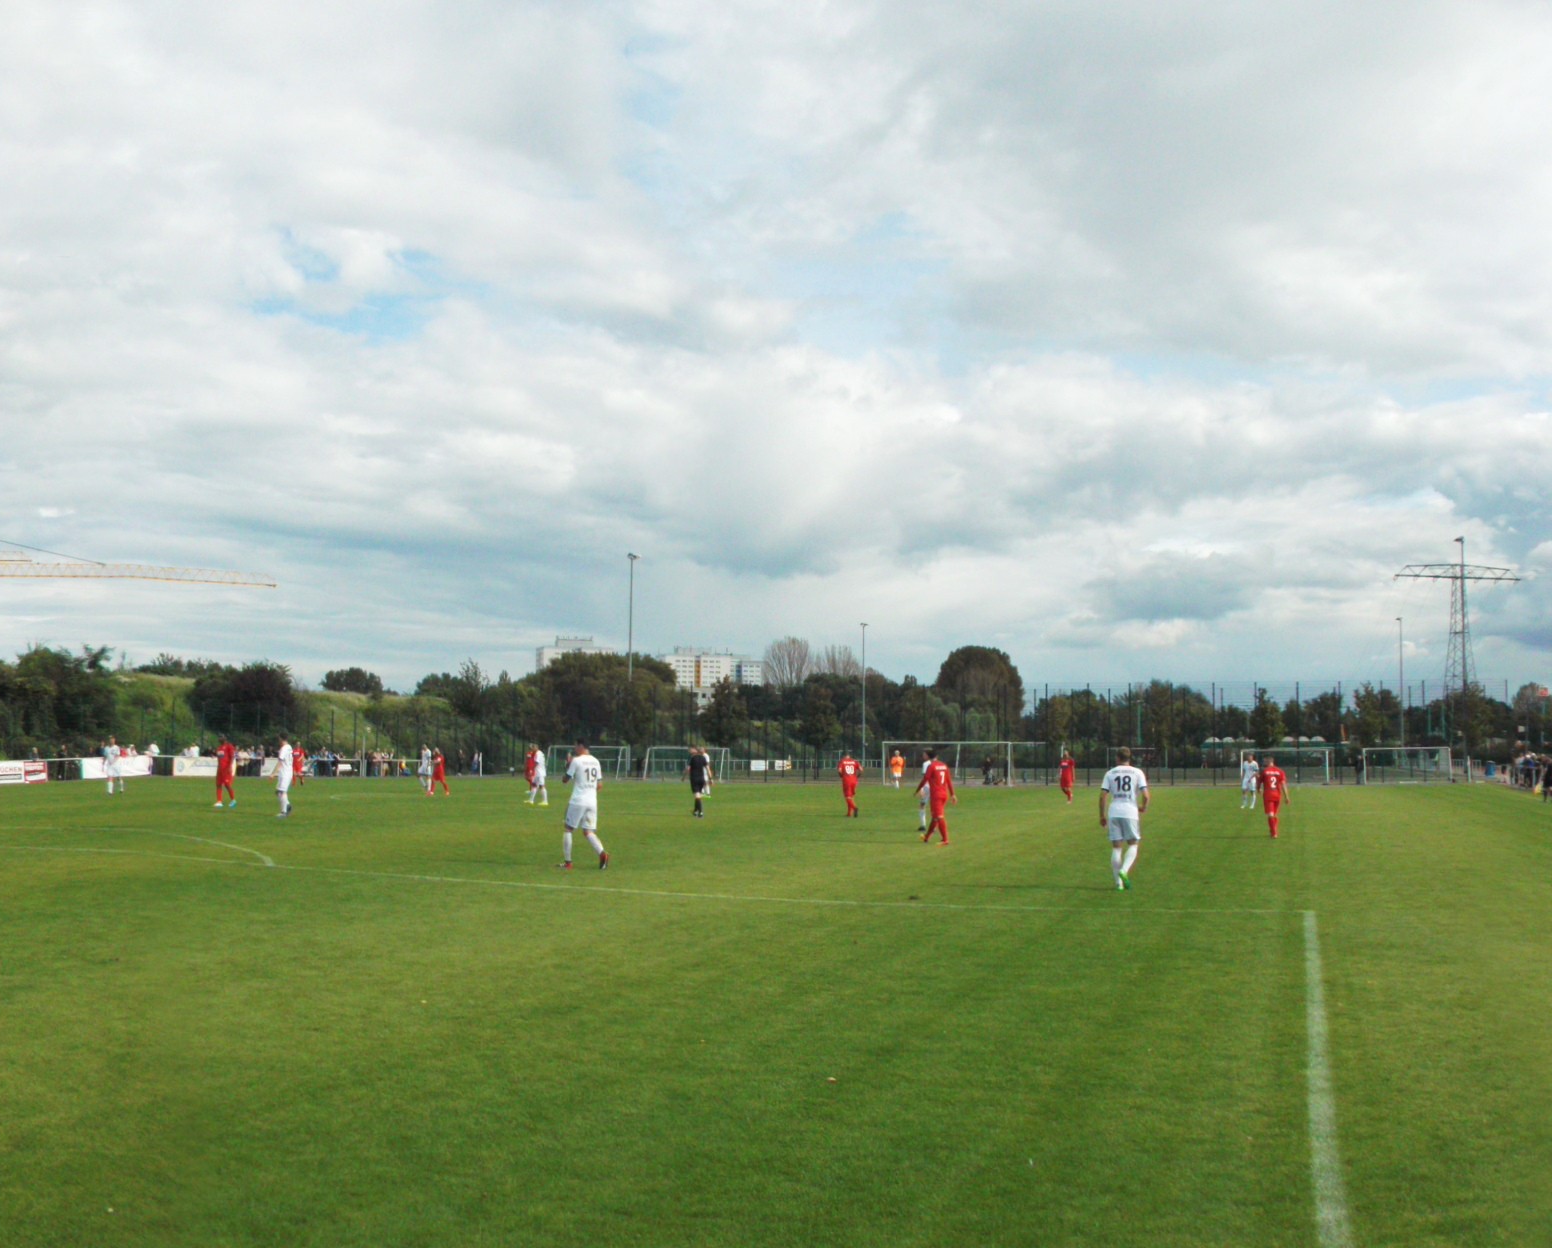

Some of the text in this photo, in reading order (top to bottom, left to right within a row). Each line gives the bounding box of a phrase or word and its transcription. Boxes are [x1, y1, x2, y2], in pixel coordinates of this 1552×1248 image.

[584, 767, 598, 783] 19
[939, 771, 945, 784] 7
[1270, 776, 1277, 788] 2
[1114, 775, 1131, 792] 18
